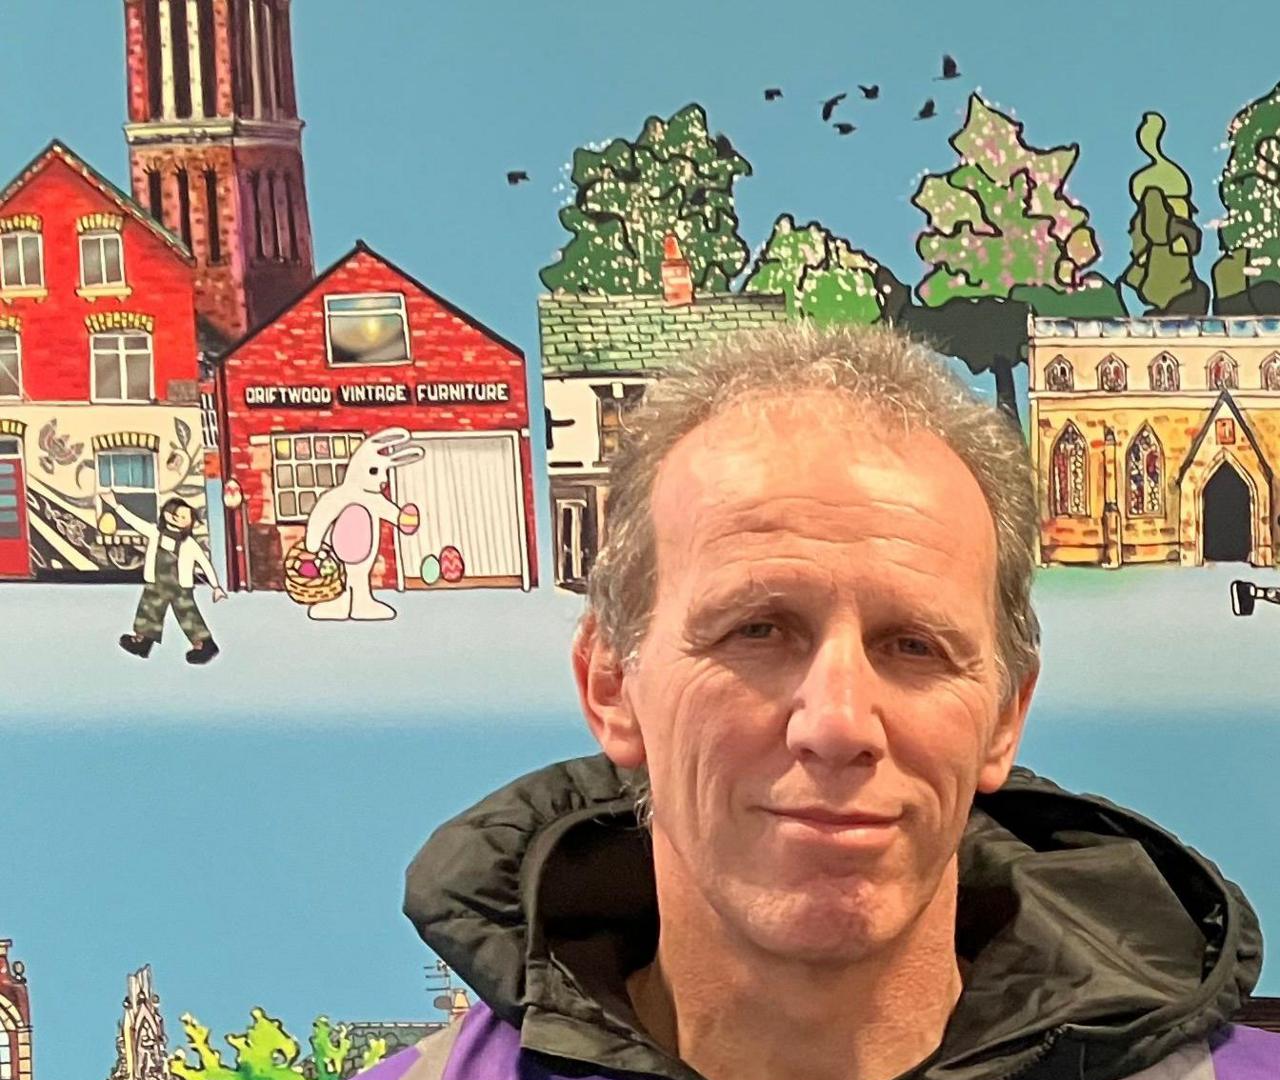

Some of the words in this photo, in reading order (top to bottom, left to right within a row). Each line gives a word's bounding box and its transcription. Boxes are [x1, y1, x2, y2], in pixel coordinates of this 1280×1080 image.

[244, 386, 332, 403] DRIFTWOOD
[340, 384, 406, 402] VINTAGE
[416, 383, 509, 401] FURNITURE
